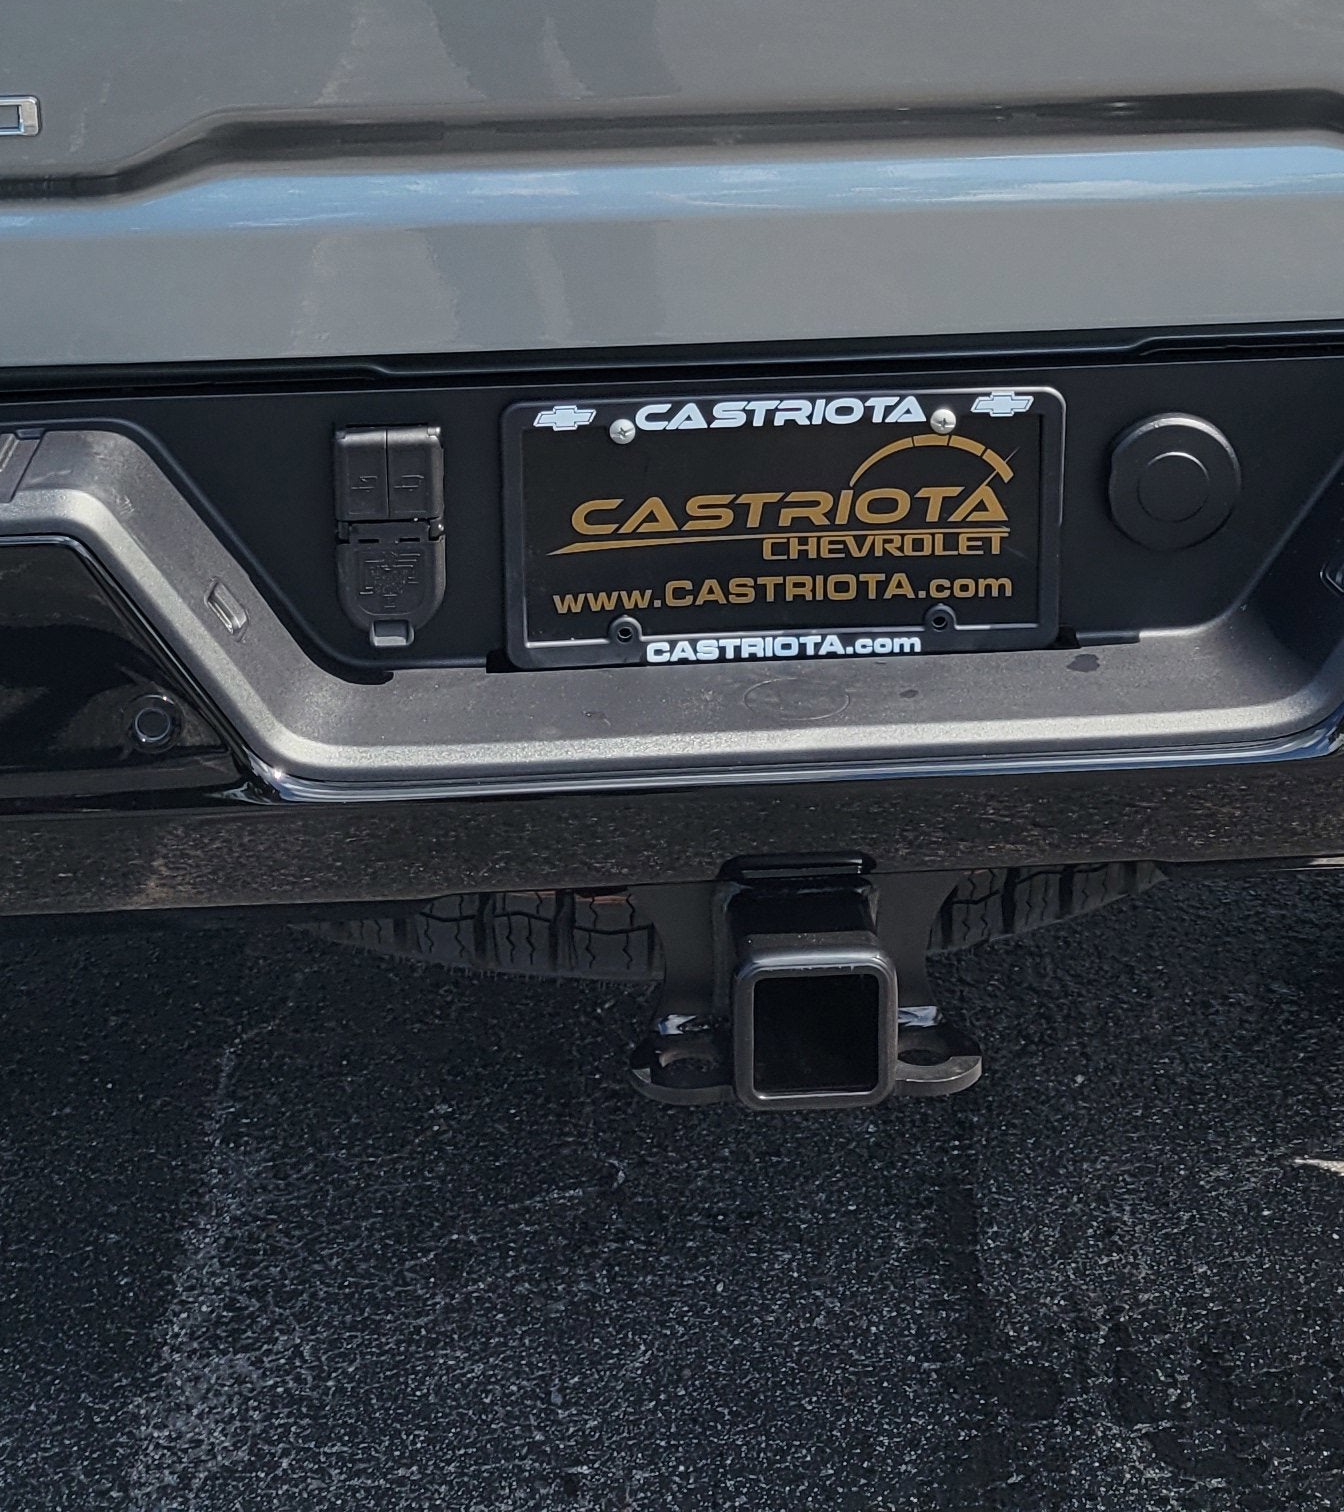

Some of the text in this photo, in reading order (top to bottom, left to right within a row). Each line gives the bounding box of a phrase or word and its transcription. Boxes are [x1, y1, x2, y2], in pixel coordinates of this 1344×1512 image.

[634, 395, 927, 430] CASTRIOTA
[570, 485, 1009, 535] CASTRIOTA
[761, 533, 1007, 561] CHEVROLET
[552, 572, 1013, 615] www.CASTRIOTA.com
[645, 634, 922, 664] CASTRIOTA.com
